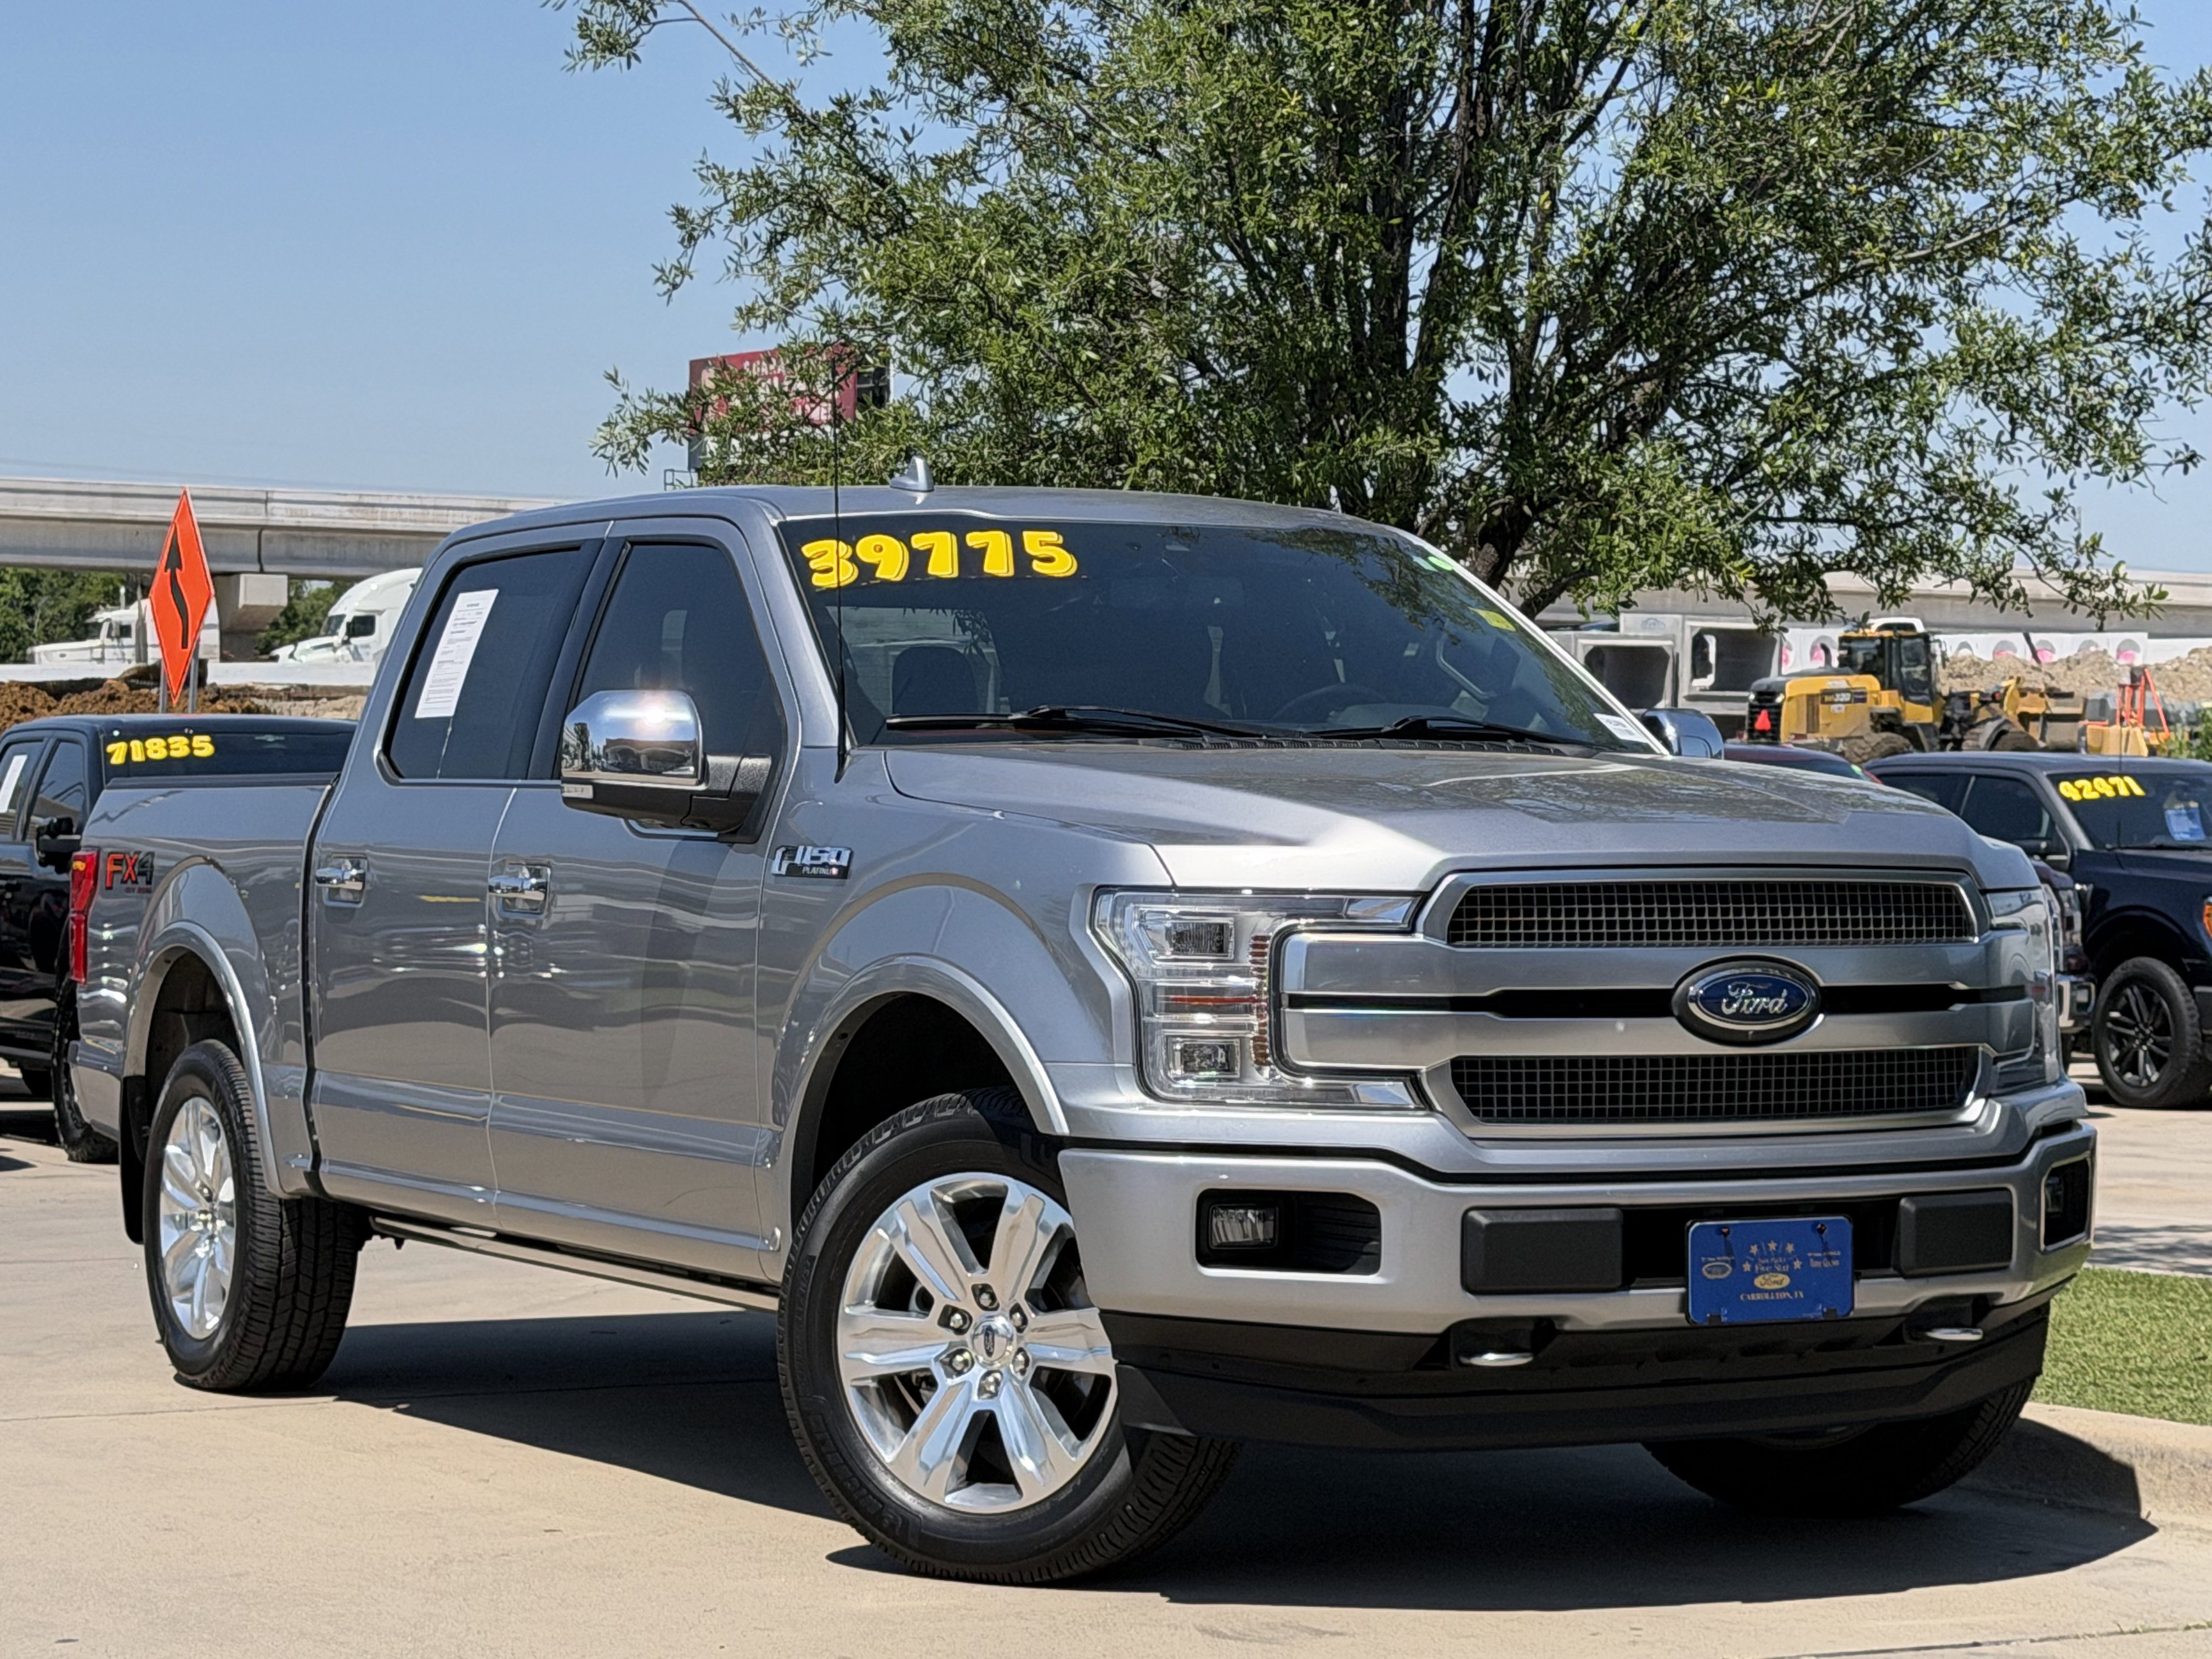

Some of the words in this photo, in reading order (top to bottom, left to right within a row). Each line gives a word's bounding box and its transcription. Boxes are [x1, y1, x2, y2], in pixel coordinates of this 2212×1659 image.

[802, 531, 1078, 588] 39775
[106, 735, 215, 765] 71835
[105, 851, 155, 890] FX4
[802, 867, 838, 876] PLATINU
[1722, 981, 1787, 1015] Ford
[1759, 1274, 1785, 1286] Ford
